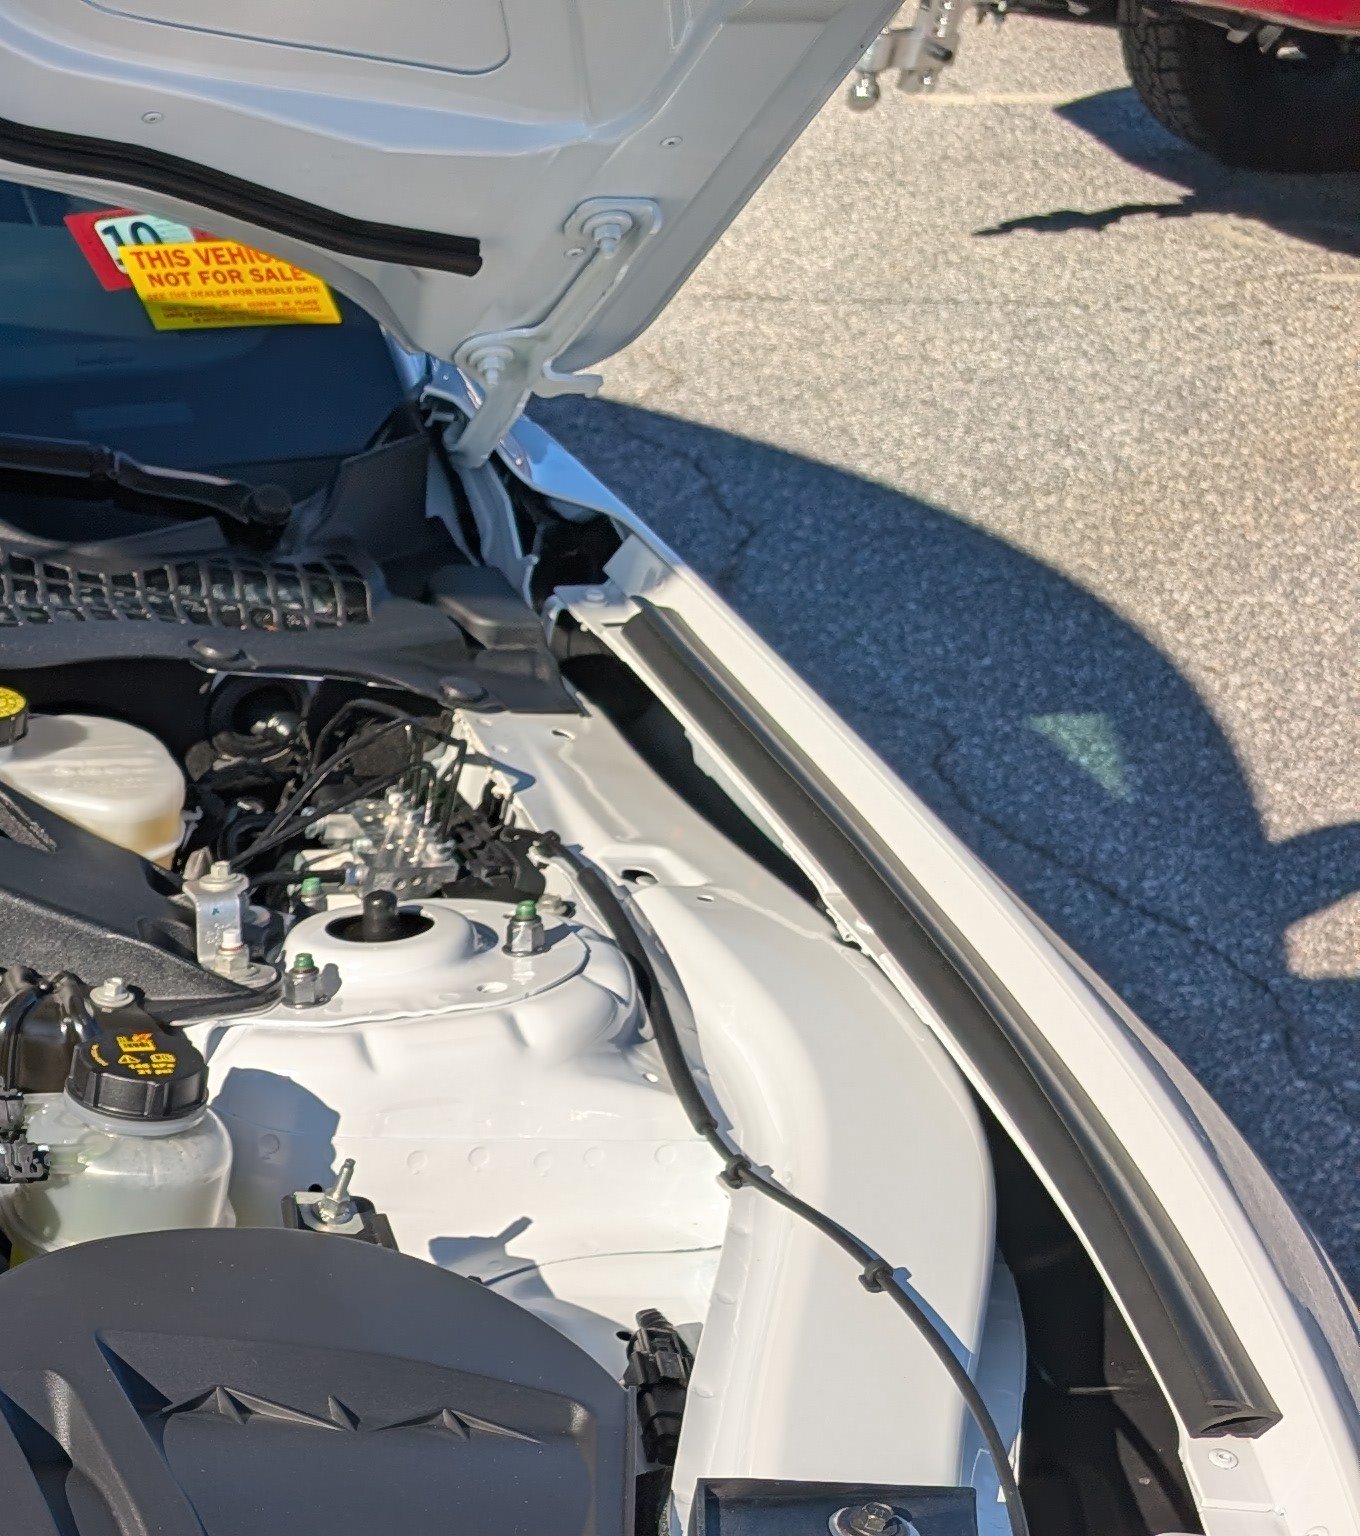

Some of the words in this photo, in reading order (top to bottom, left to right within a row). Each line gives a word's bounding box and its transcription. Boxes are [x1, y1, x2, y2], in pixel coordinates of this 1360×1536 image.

[130, 248, 191, 271] THIS
[193, 246, 278, 268] VEHIC
[146, 272, 194, 288] NOT
[197, 269, 243, 285] FOR
[251, 264, 307, 284] SALE
